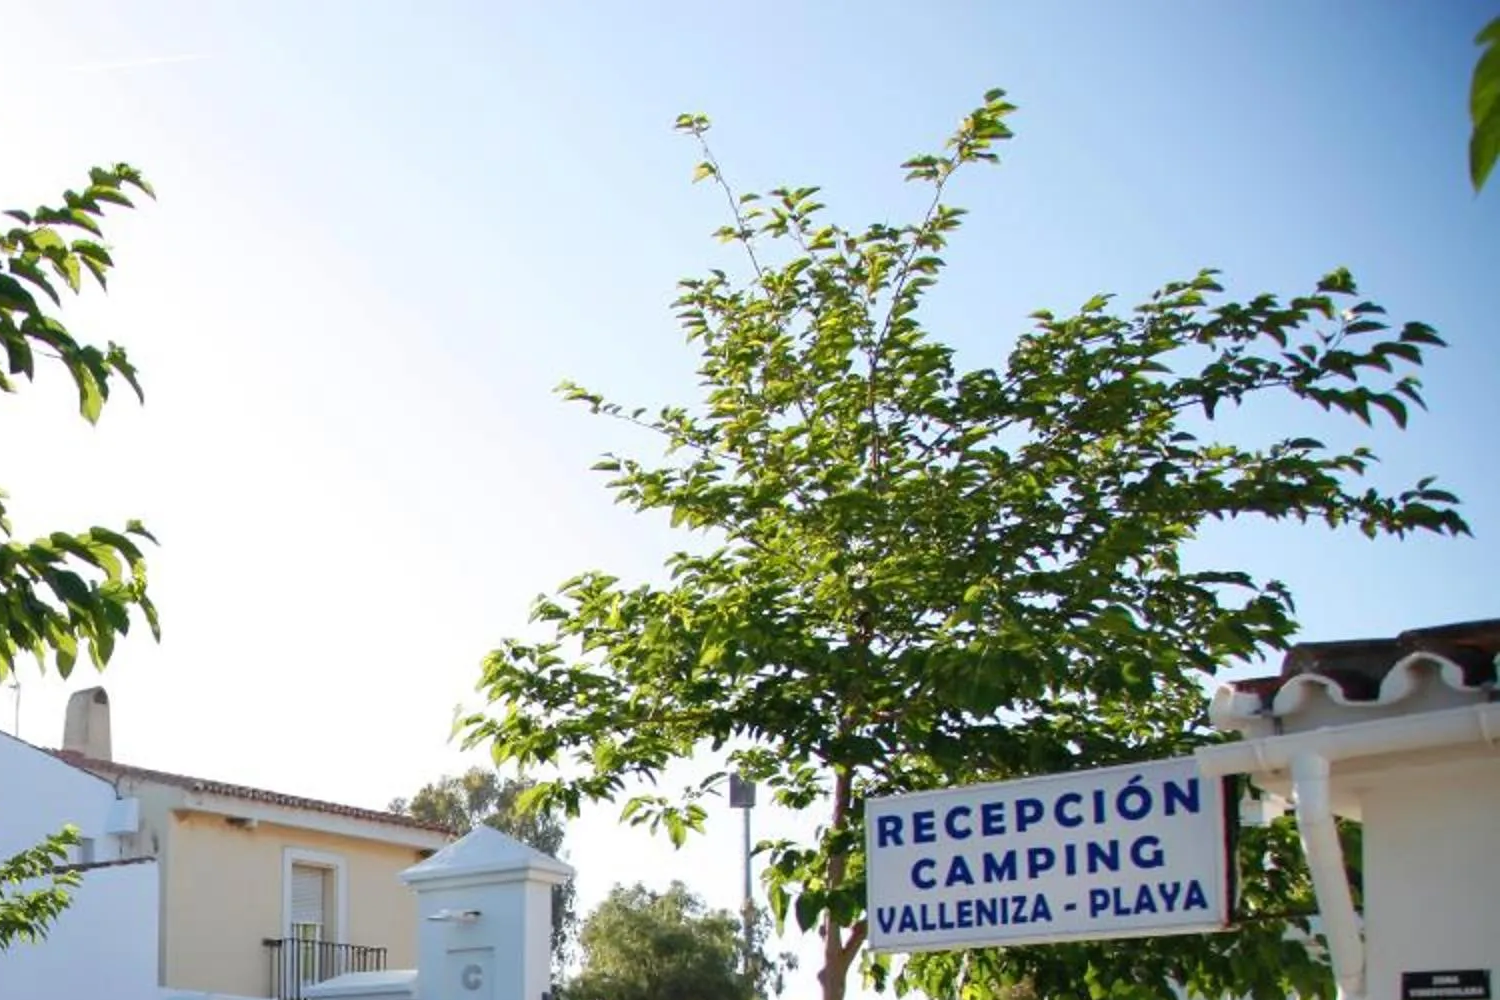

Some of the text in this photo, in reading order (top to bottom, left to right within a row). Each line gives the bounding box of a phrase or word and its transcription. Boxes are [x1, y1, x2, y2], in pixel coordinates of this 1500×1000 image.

[877, 774, 1200, 848] RECEPCIÓN
[911, 835, 1165, 889] CAMPING
[877, 893, 1053, 934] VALLENIZA
[1089, 879, 1208, 918] PLAYA
